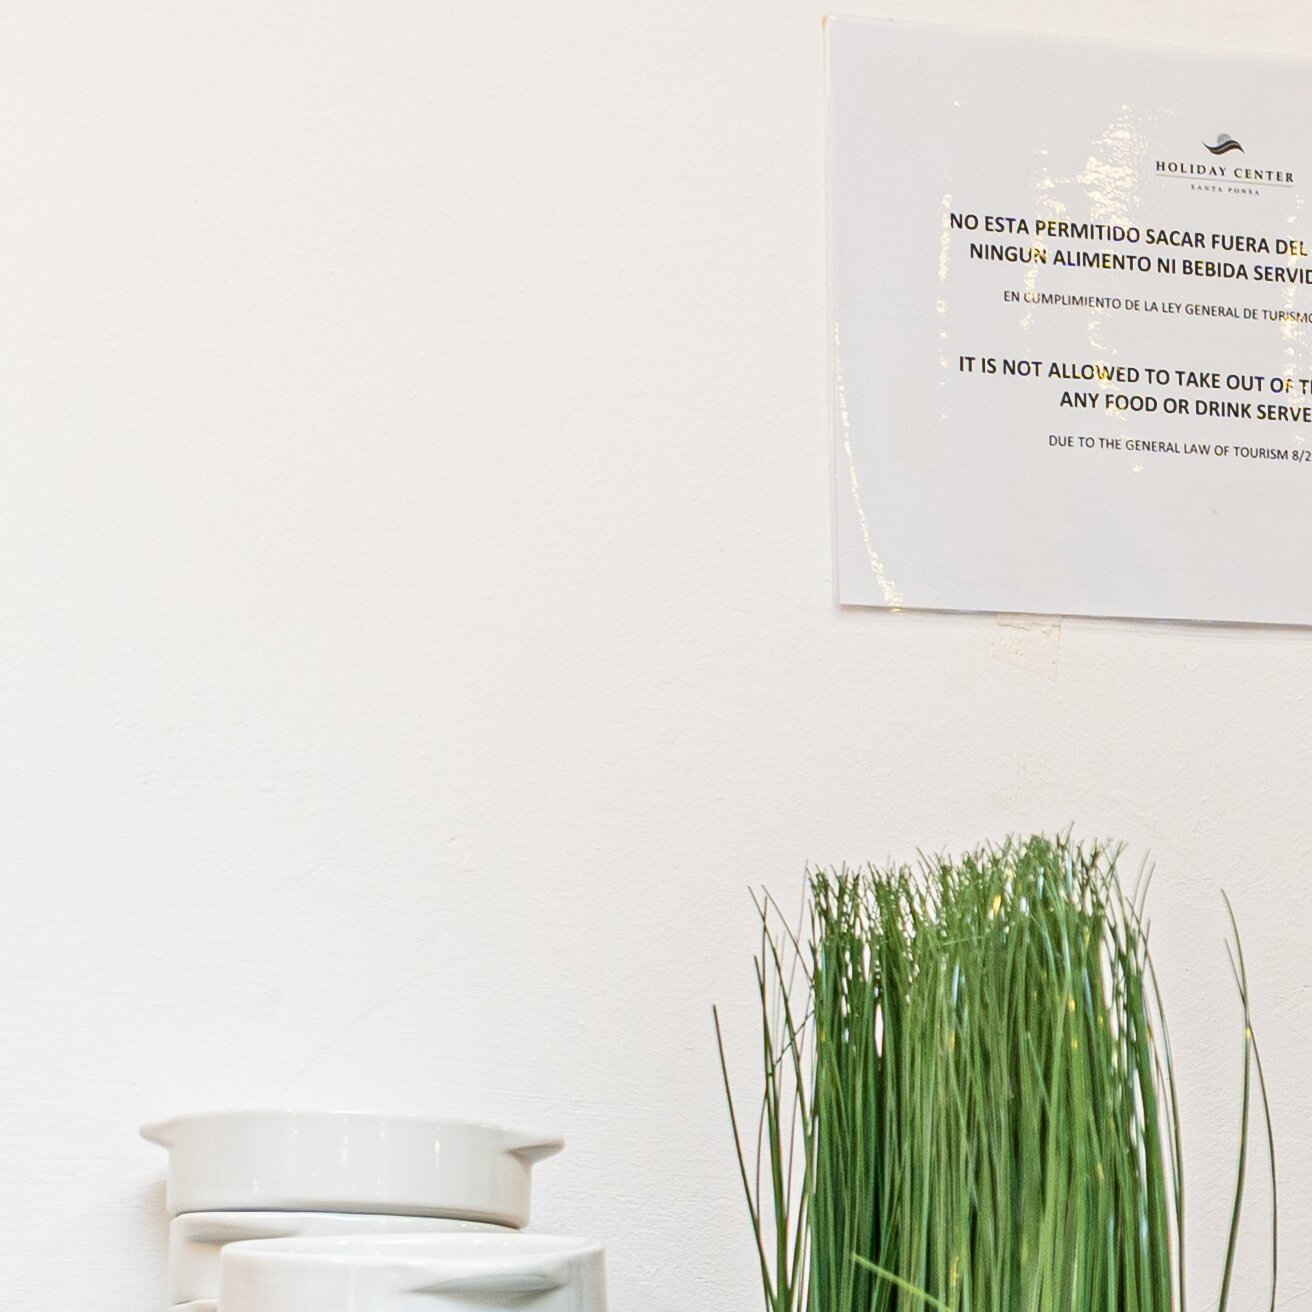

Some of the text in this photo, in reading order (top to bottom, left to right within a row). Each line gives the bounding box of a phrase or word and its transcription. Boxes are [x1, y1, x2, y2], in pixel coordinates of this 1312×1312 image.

[1156, 161, 1294, 182] HOLIDAY CENTER
[950, 214, 978, 230] NO
[985, 216, 1029, 234] ESTA
[1036, 220, 1140, 243] PERMITIDO
[1146, 229, 1205, 248] SACAR
[1212, 234, 1270, 253] FUERA
[1276, 239, 1307, 256] DEL
[970, 243, 1046, 264] NINGUN
[1053, 250, 1150, 272] ALIMENTO
[1158, 258, 1175, 274] NI
[1183, 260, 1248, 279] BEBIDA
[1004, 291, 1019, 302] EN
[1024, 292, 1121, 309] CUMPLIMIENTO
[1126, 299, 1140, 311] DE
[1144, 301, 1158, 312] LA
[1162, 302, 1182, 314] LEY
[1186, 304, 1239, 318] GENERAL
[1244, 308, 1258, 320] DE
[960, 356, 975, 372] IT
[982, 358, 996, 374] IS
[1003, 359, 1042, 377] NOT
[1048, 362, 1140, 382] ALLOWED
[1145, 368, 1170, 385] TO
[1175, 370, 1220, 388] TAKE
[1226, 374, 1264, 392] OUT
[1270, 378, 1293, 394] OF
[1060, 392, 1100, 408] ANY
[1106, 394, 1158, 412] FOOD
[1164, 398, 1190, 414] OR
[1196, 400, 1251, 419] DRINK
[1049, 435, 1074, 447] DUE
[1078, 436, 1095, 448] TO
[1099, 438, 1122, 450] THE
[1126, 440, 1180, 454] GENERAL
[1184, 443, 1210, 455] LAW
[1215, 446, 1230, 456] OF
[1234, 446, 1288, 460] TOURISM
